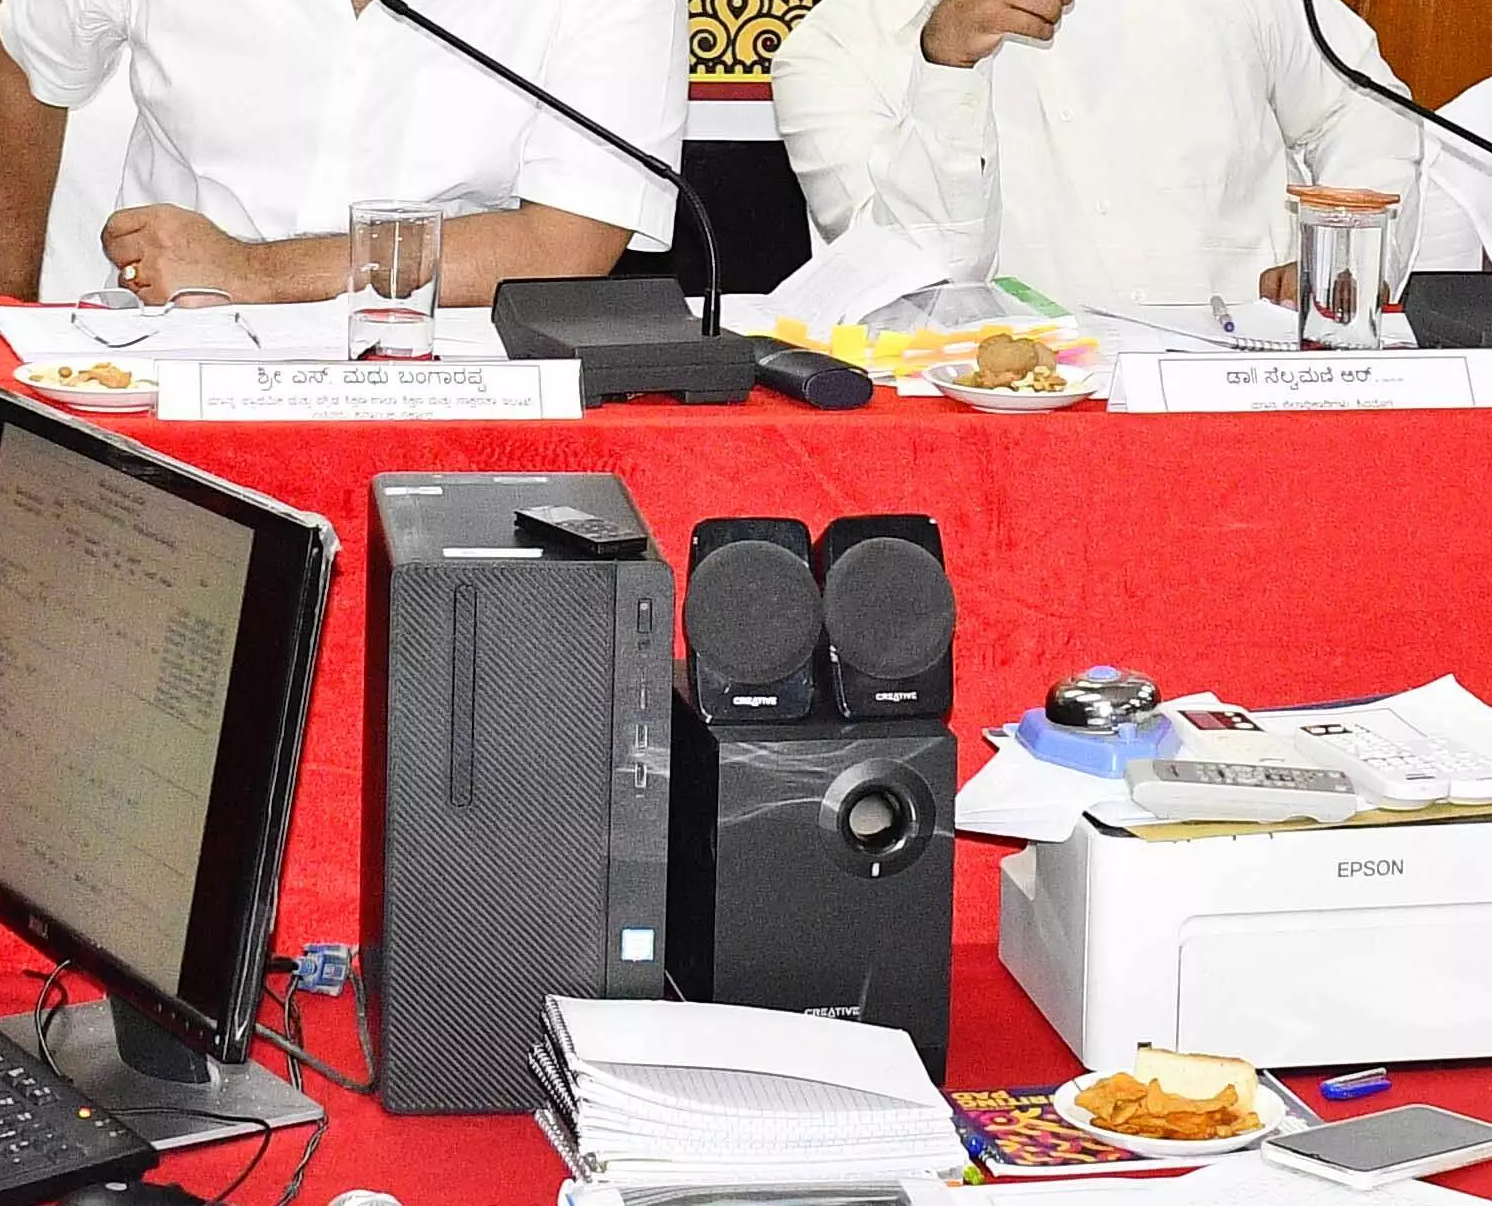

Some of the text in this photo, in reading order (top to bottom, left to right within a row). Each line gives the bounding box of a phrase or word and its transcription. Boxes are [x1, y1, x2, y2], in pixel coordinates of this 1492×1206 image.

[257, 366, 283, 391] ಶ್ರೀ
[343, 367, 389, 387] ಮಧು
[398, 367, 487, 393] ಬಂಗಾರಪ್ಪ
[1264, 366, 1334, 390] ಸೆಲ್ವಮಣಿ
[732, 695, 778, 707] CREATIVE
[874, 691, 917, 702] CREATIVE
[1337, 859, 1404, 878] EPSON
[804, 1006, 861, 1018] CREATIVE
[956, 1094, 1055, 1109] RITING
